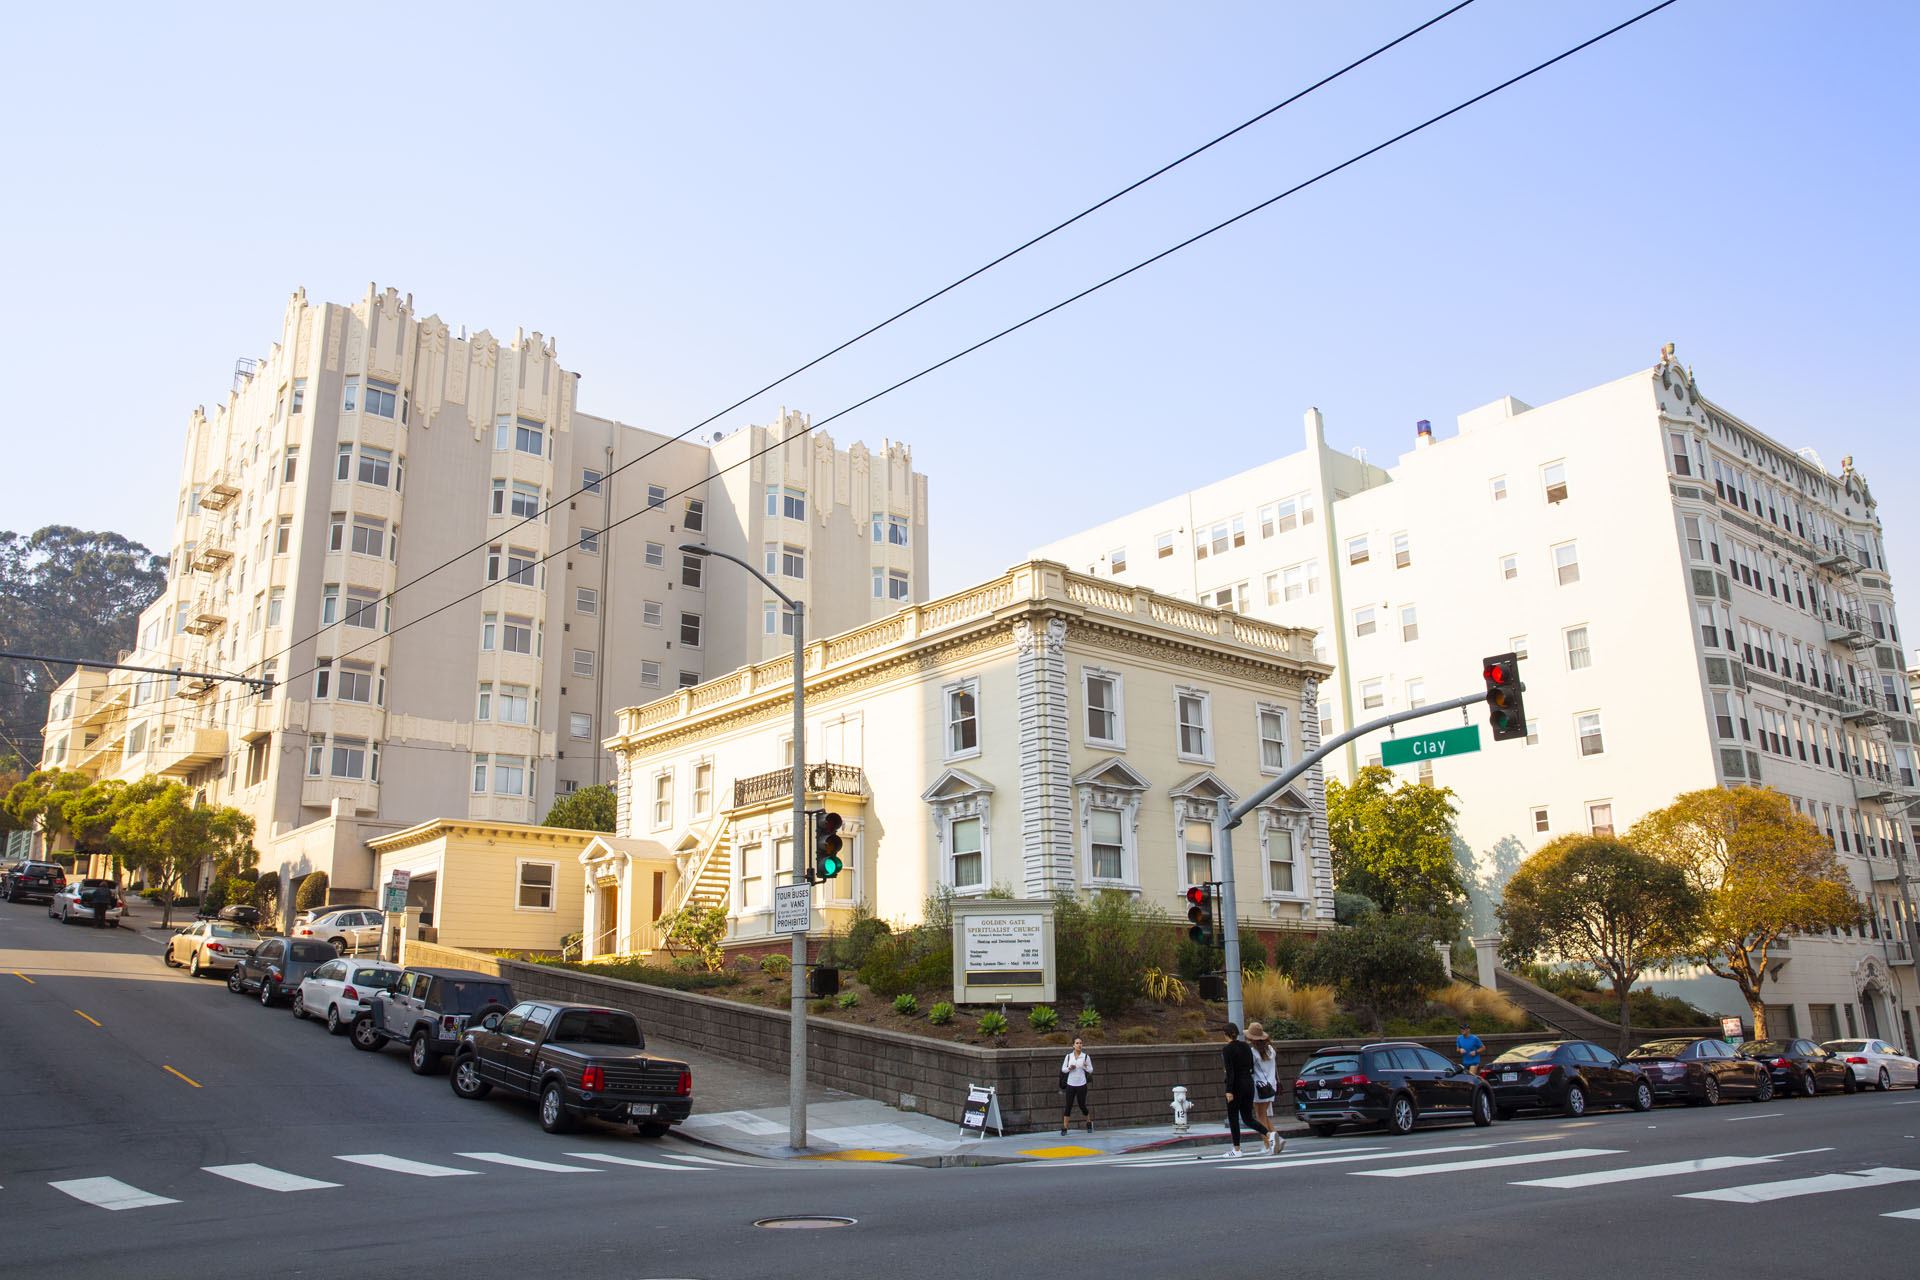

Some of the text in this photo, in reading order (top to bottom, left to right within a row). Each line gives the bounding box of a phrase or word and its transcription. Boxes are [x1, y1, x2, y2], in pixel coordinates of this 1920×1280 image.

[1413, 740, 1445, 755] Clay
[777, 890, 808, 900] TOUR BUSES
[790, 900, 804, 908] VANS
[778, 918, 808, 928] PROHIBITED
